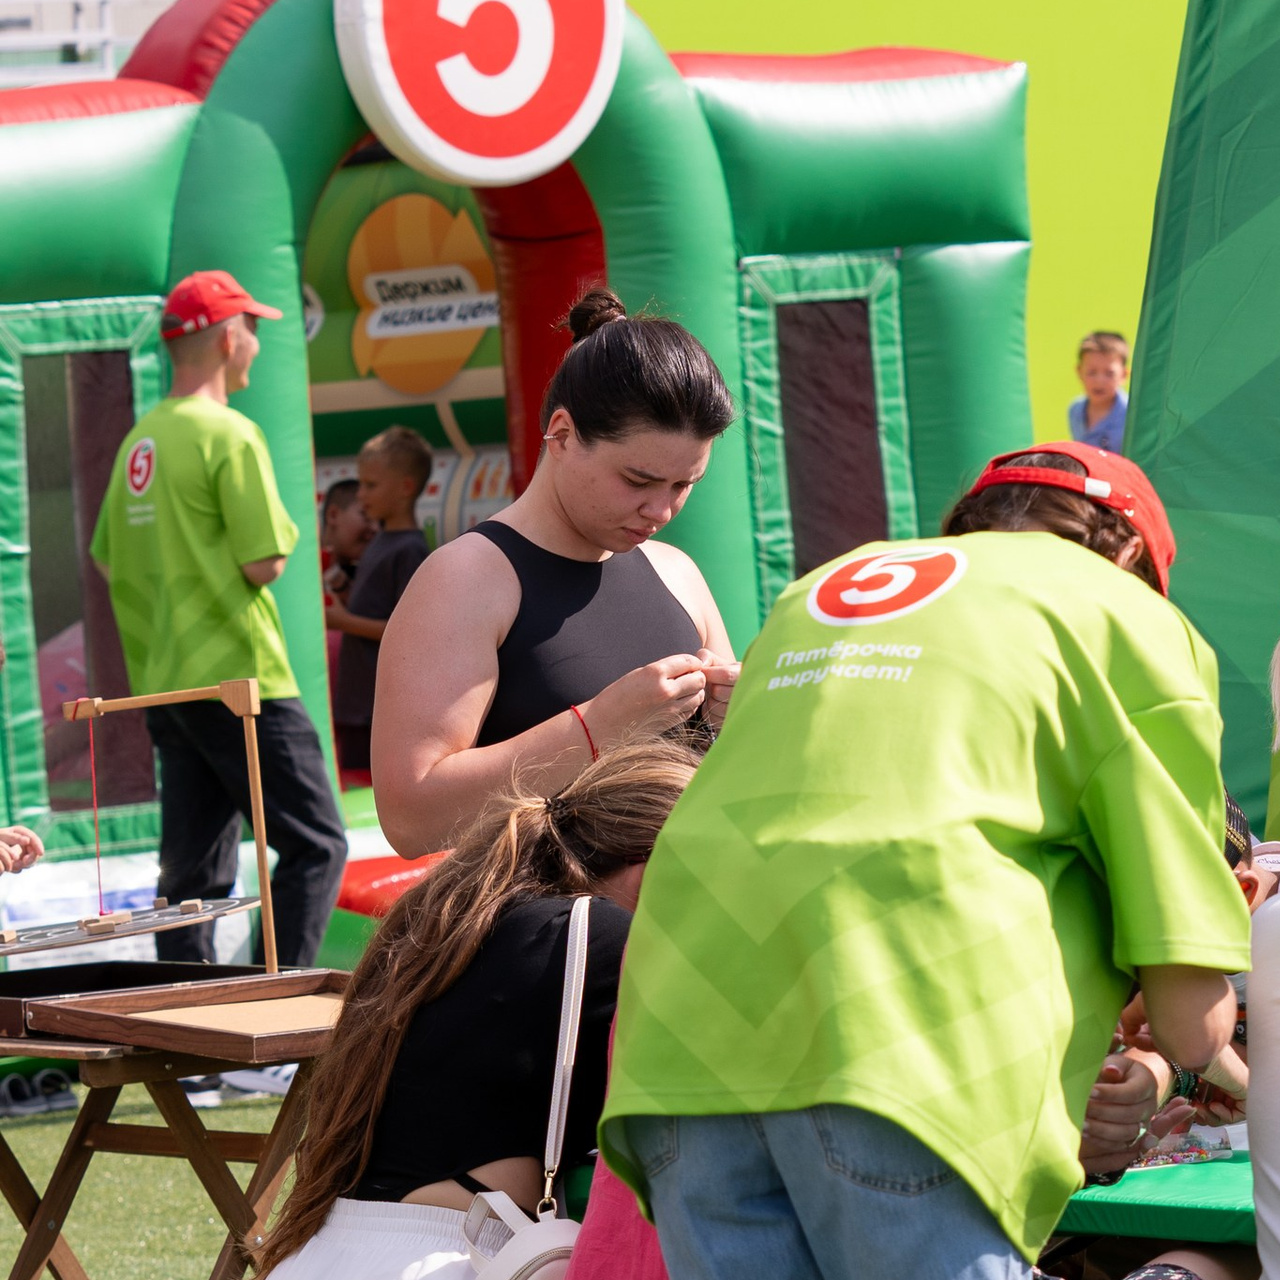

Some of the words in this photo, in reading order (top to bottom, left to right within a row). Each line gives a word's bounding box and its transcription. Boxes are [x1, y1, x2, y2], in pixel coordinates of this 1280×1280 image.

[456, 300, 499, 322] цен
[775, 641, 923, 669] Пятёрочка
[767, 664, 914, 691] выручает!
